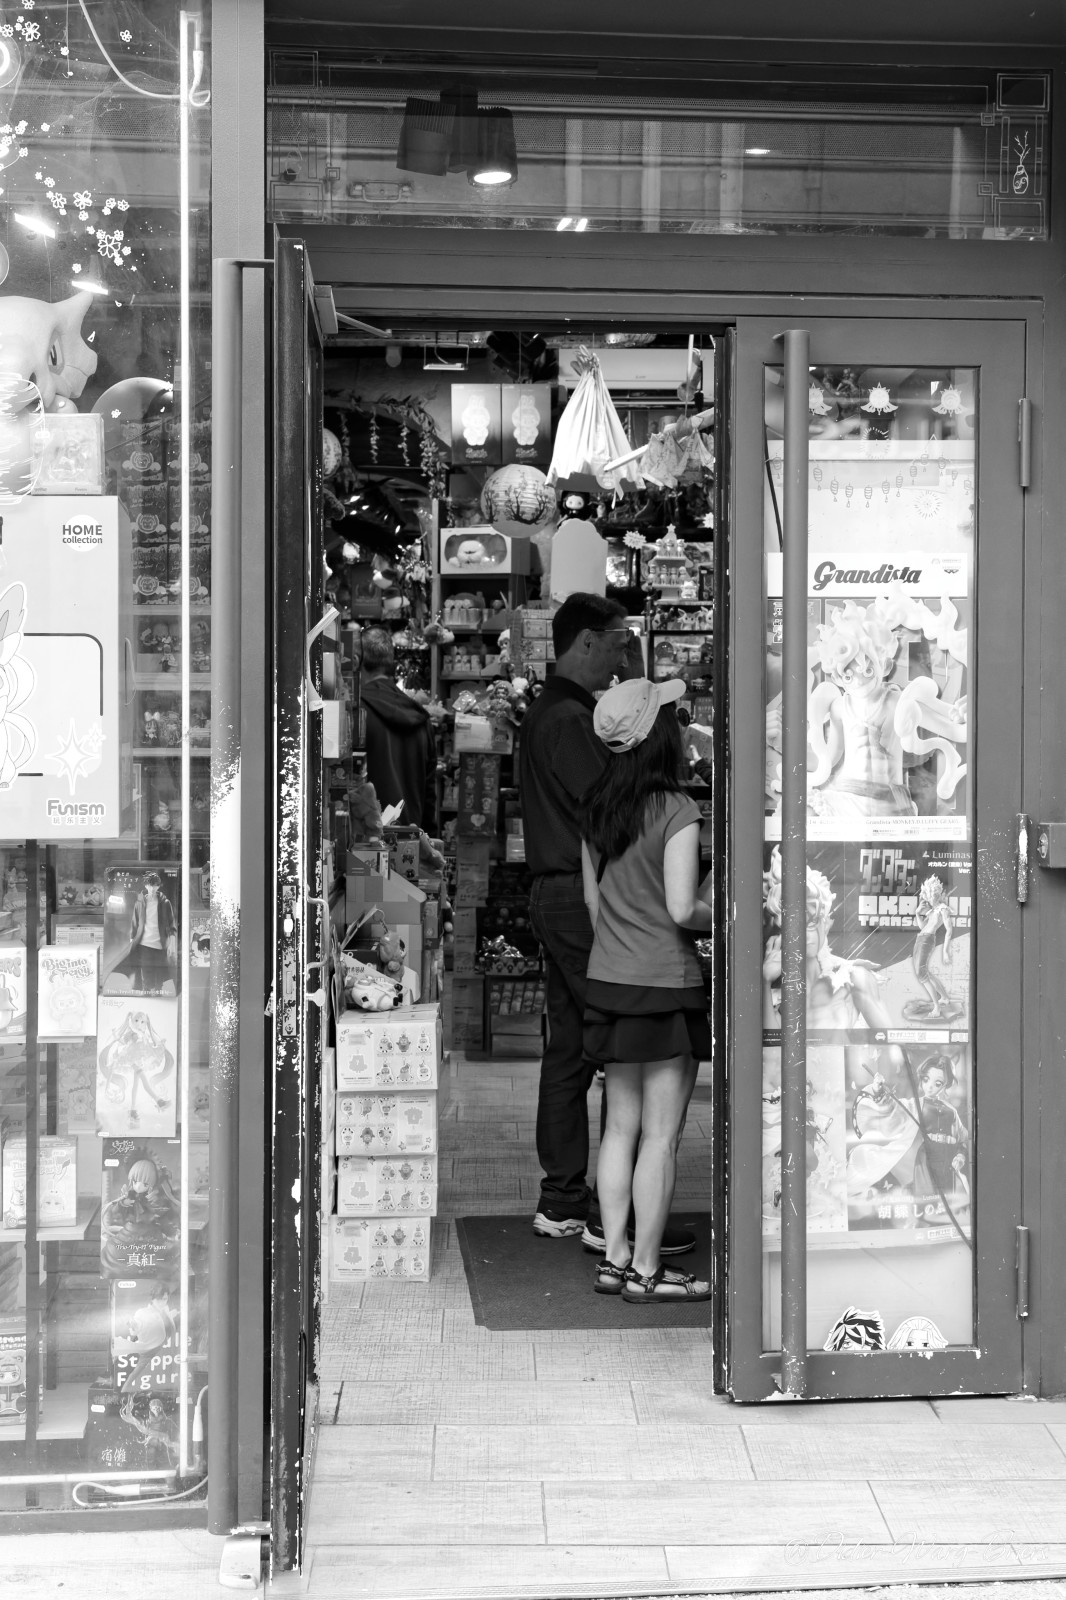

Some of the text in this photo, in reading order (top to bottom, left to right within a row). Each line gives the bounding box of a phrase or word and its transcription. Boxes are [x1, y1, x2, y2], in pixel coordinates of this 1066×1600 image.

[62, 524, 103, 536] HOME
[62, 536, 103, 545] collection
[812, 561, 922, 591] Grandista
[47, 800, 105, 816] Funism
[53, 817, 101, 825] 玩乐主义
